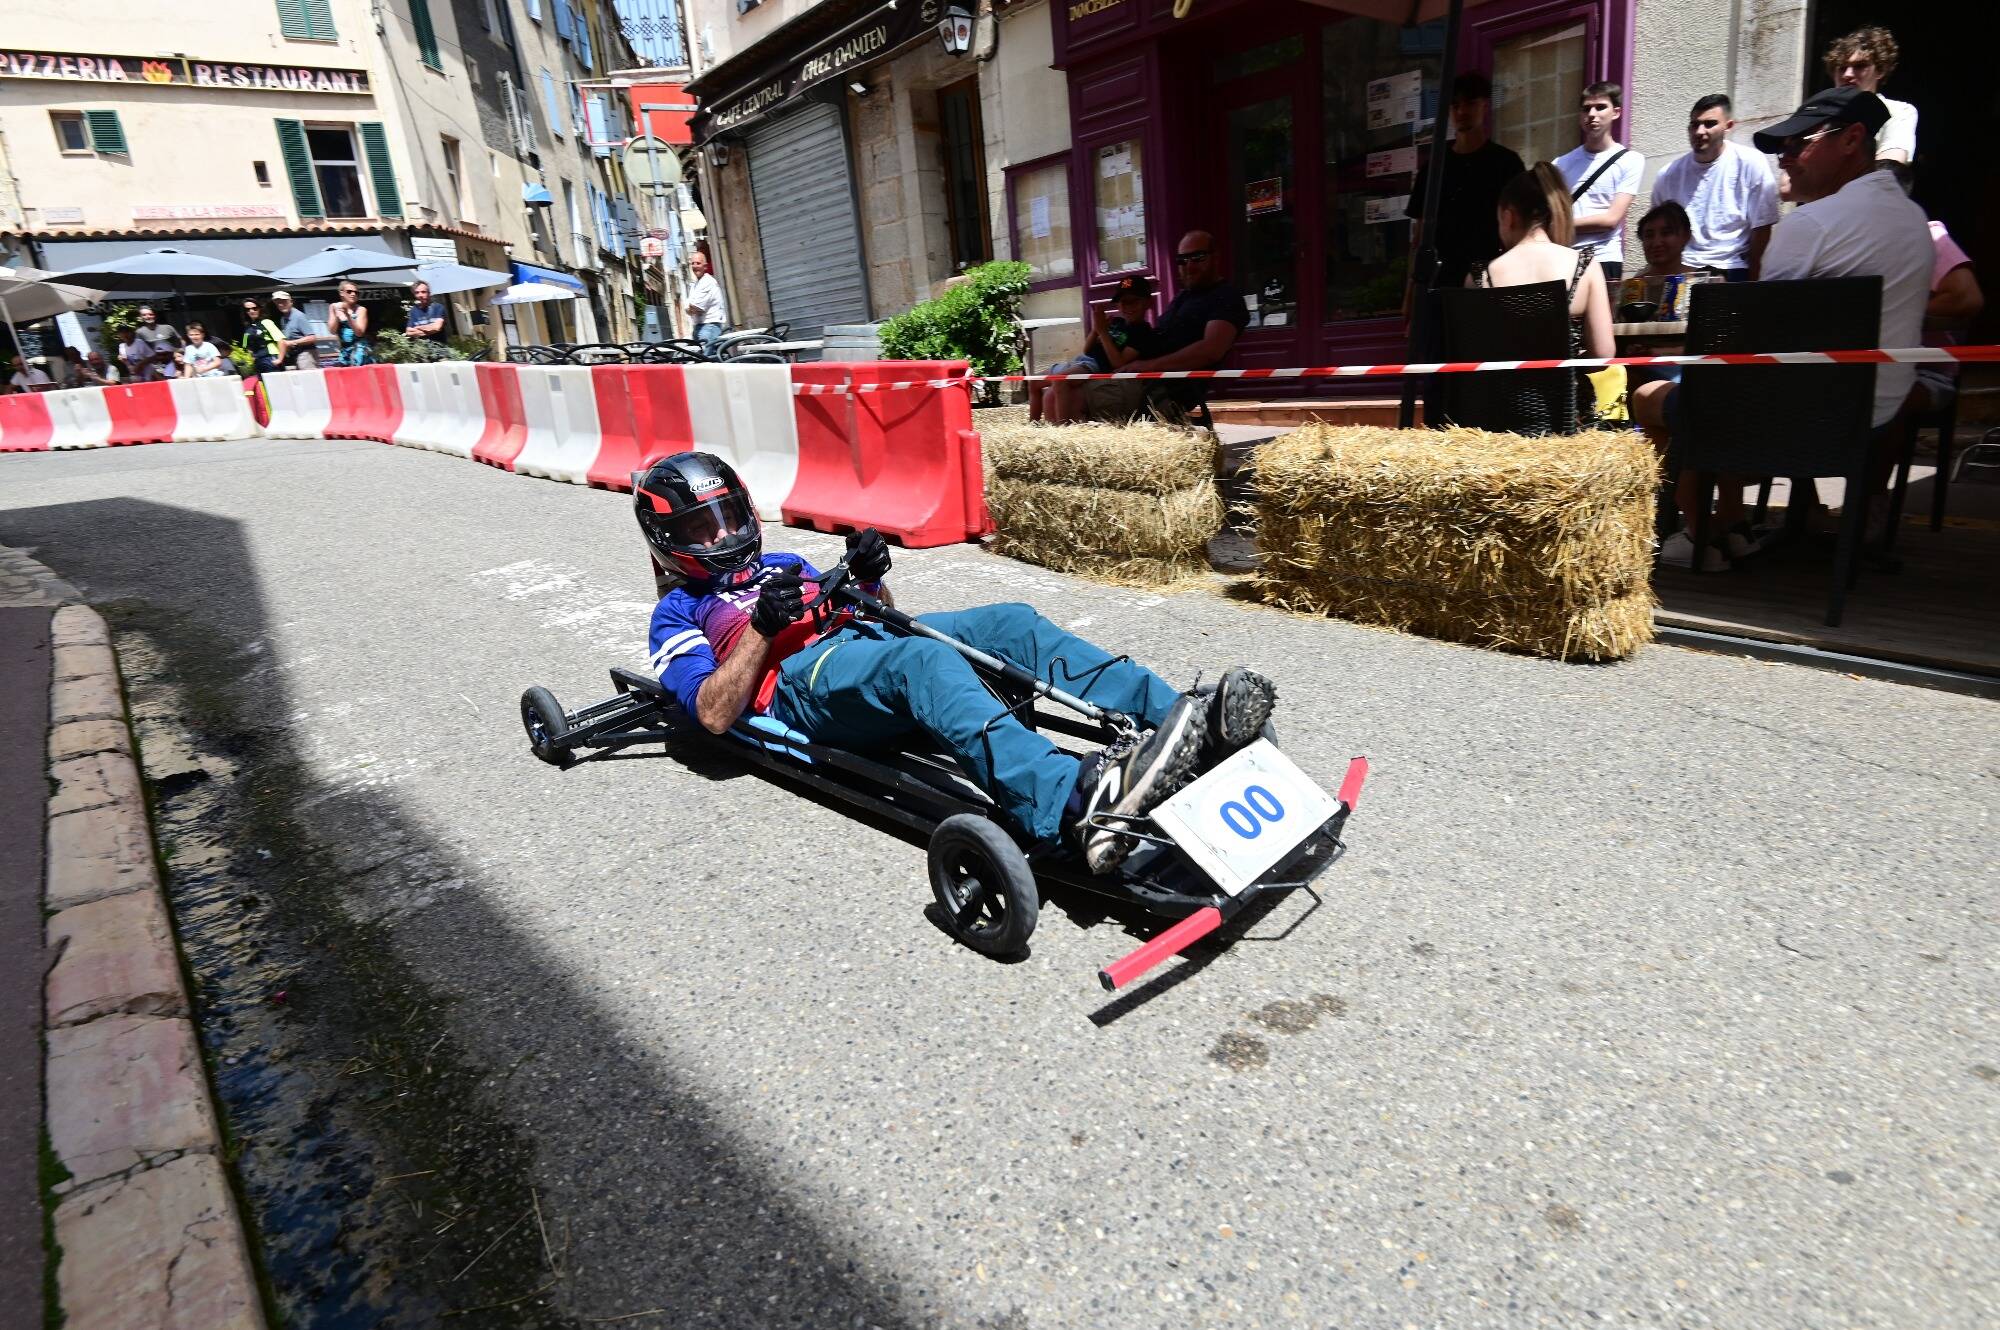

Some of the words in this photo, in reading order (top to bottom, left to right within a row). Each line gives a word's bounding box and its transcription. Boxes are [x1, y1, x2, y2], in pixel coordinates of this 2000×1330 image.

[0, 53, 128, 81] PIZZERIA
[195, 64, 360, 92] RESTAURANT
[743, 80, 784, 114] CENTRAL
[802, 52, 832, 81] CHEZ
[834, 25, 886, 67] DAMIEN
[1220, 785, 1285, 840] 00
